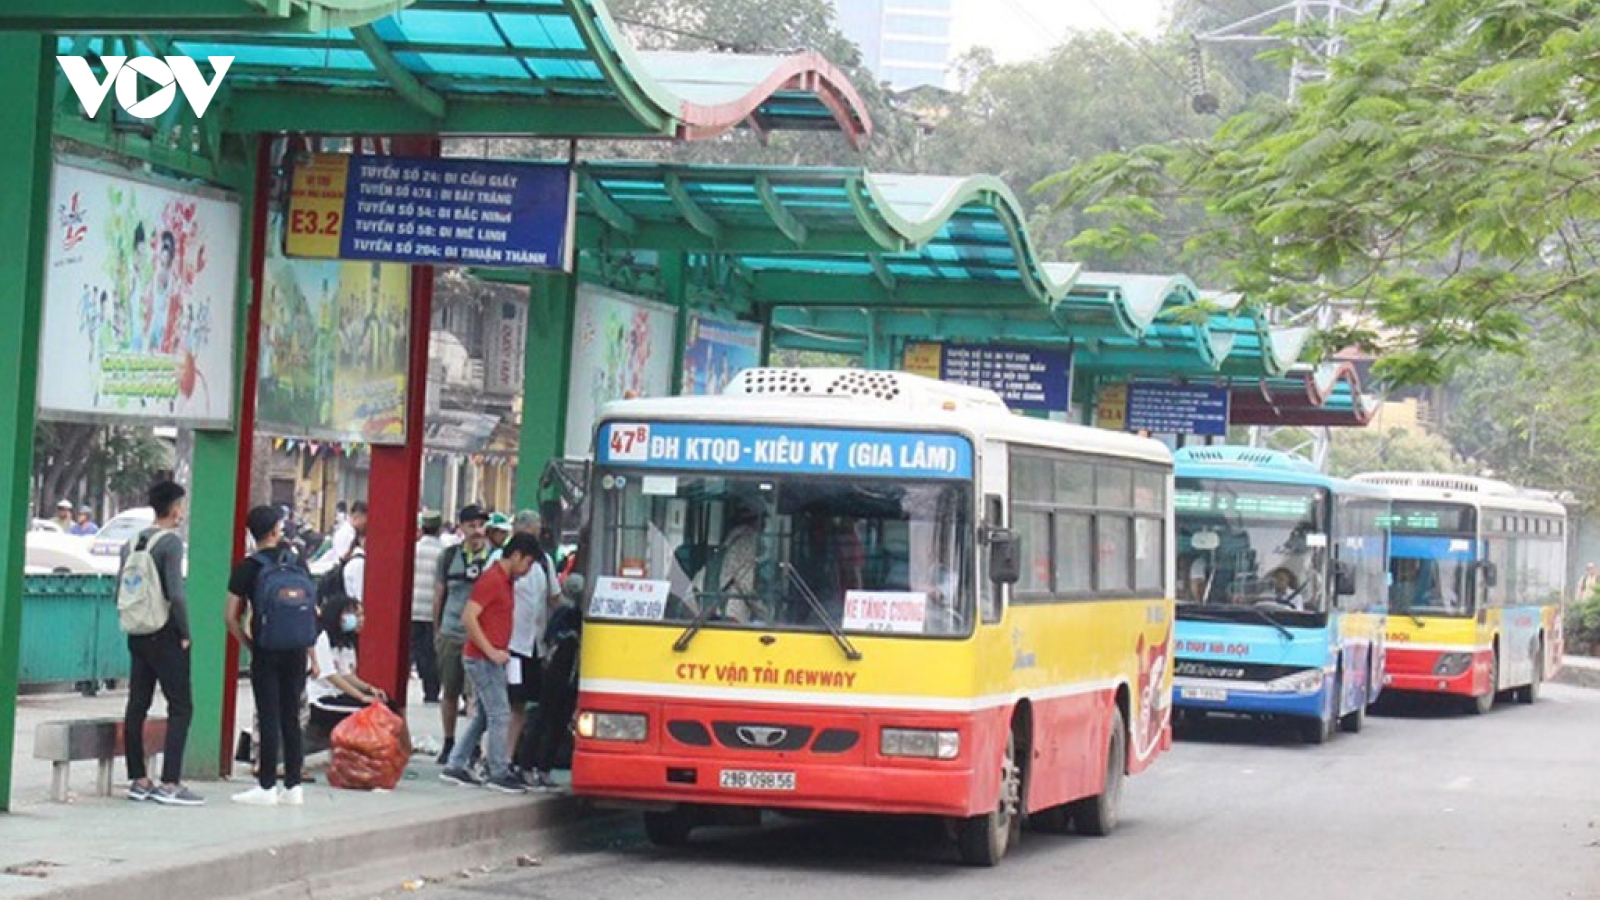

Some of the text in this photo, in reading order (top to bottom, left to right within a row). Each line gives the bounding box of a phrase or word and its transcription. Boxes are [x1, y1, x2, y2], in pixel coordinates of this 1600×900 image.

[361, 165, 399, 179] TUYẾN
[402, 167, 419, 180] SỐ
[444, 172, 458, 184] ĐI
[489, 173, 517, 188] GIẤY
[360, 182, 392, 196] TUYẾN
[395, 184, 409, 197] SỐ
[358, 200, 395, 215] TUYẾN
[398, 203, 414, 216] SỐ
[438, 207, 450, 219] ĐI
[291, 208, 339, 235] E3.2
[355, 219, 395, 233] TUYẾN
[397, 221, 415, 235] SỐ
[439, 225, 452, 238] ĐI
[478, 228, 507, 243] LINH
[353, 238, 394, 252] TUYẾN
[395, 240, 412, 254] SỐ
[444, 245, 458, 258] ĐI
[651, 436, 679, 459] ĐH
[685, 437, 740, 465] KTQD
[755, 434, 804, 465] KIÊU
[849, 442, 893, 468] (GIA
[900, 439, 956, 473] LÂM)
[677, 664, 710, 679] CTY
[784, 669, 856, 687] NEWWAY
